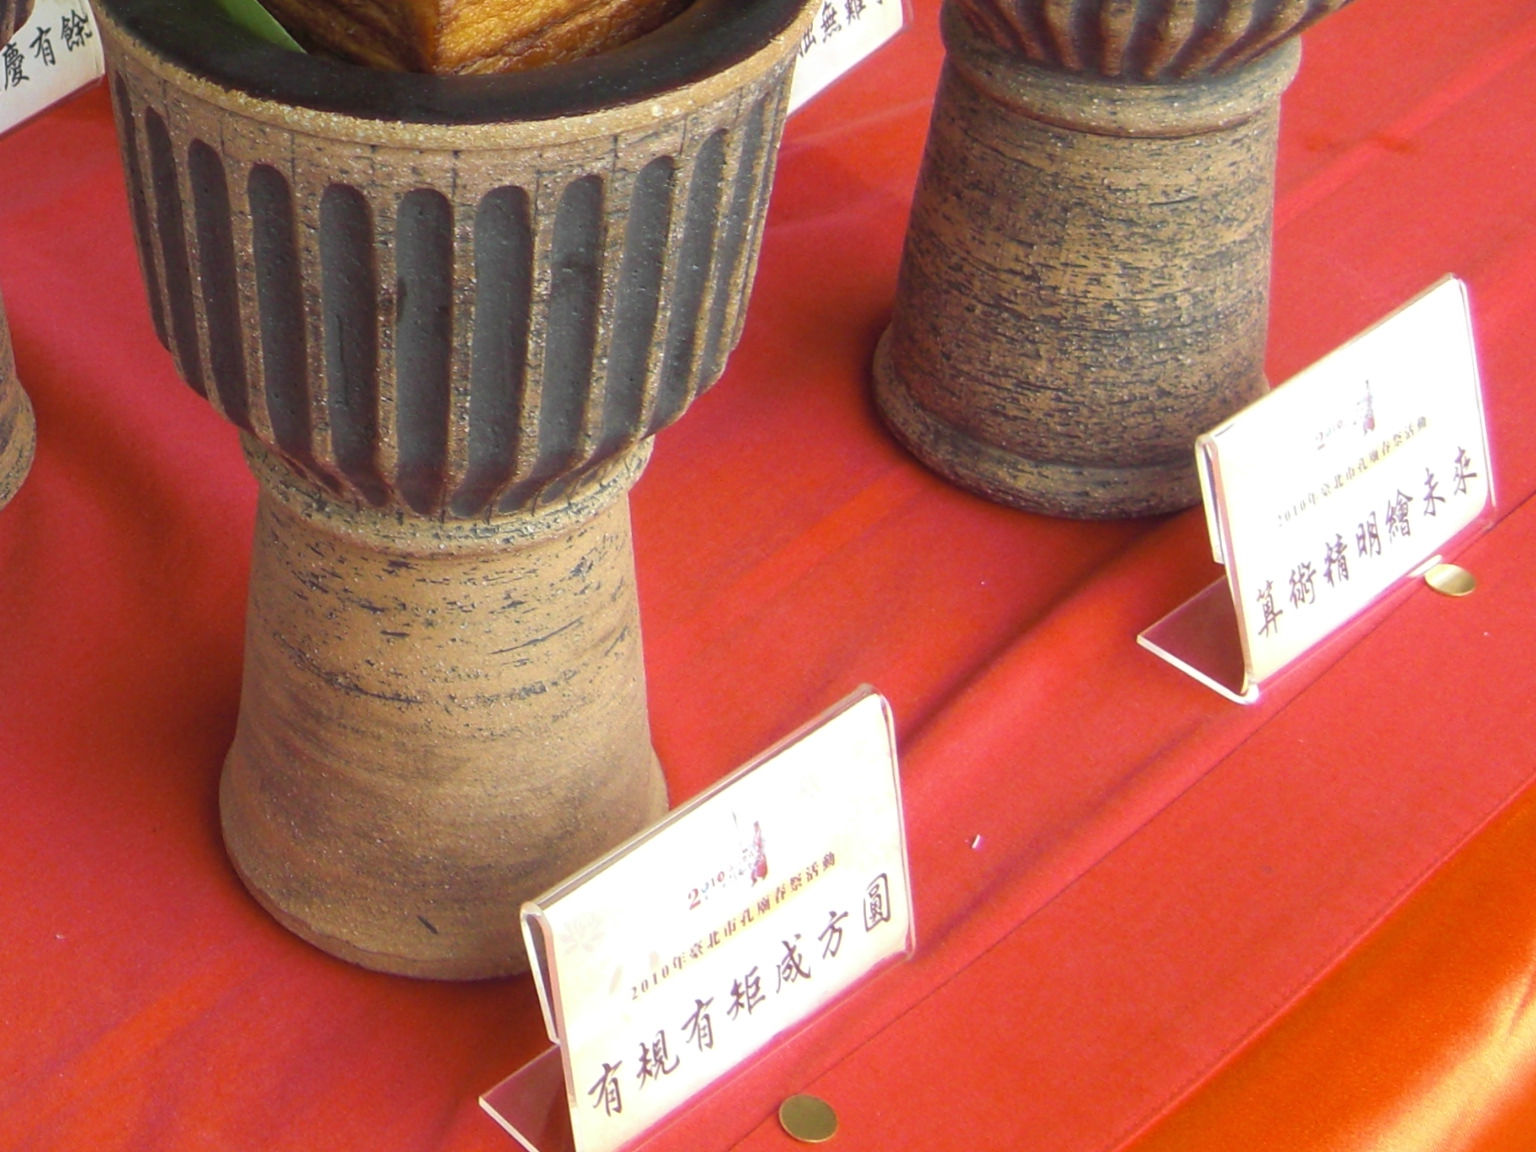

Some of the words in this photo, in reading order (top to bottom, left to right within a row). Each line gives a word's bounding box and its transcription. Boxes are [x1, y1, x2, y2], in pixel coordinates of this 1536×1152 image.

[1257, 447, 1478, 638] 算術精明繪未來
[587, 873, 891, 1117] 有規有矩成方圓
